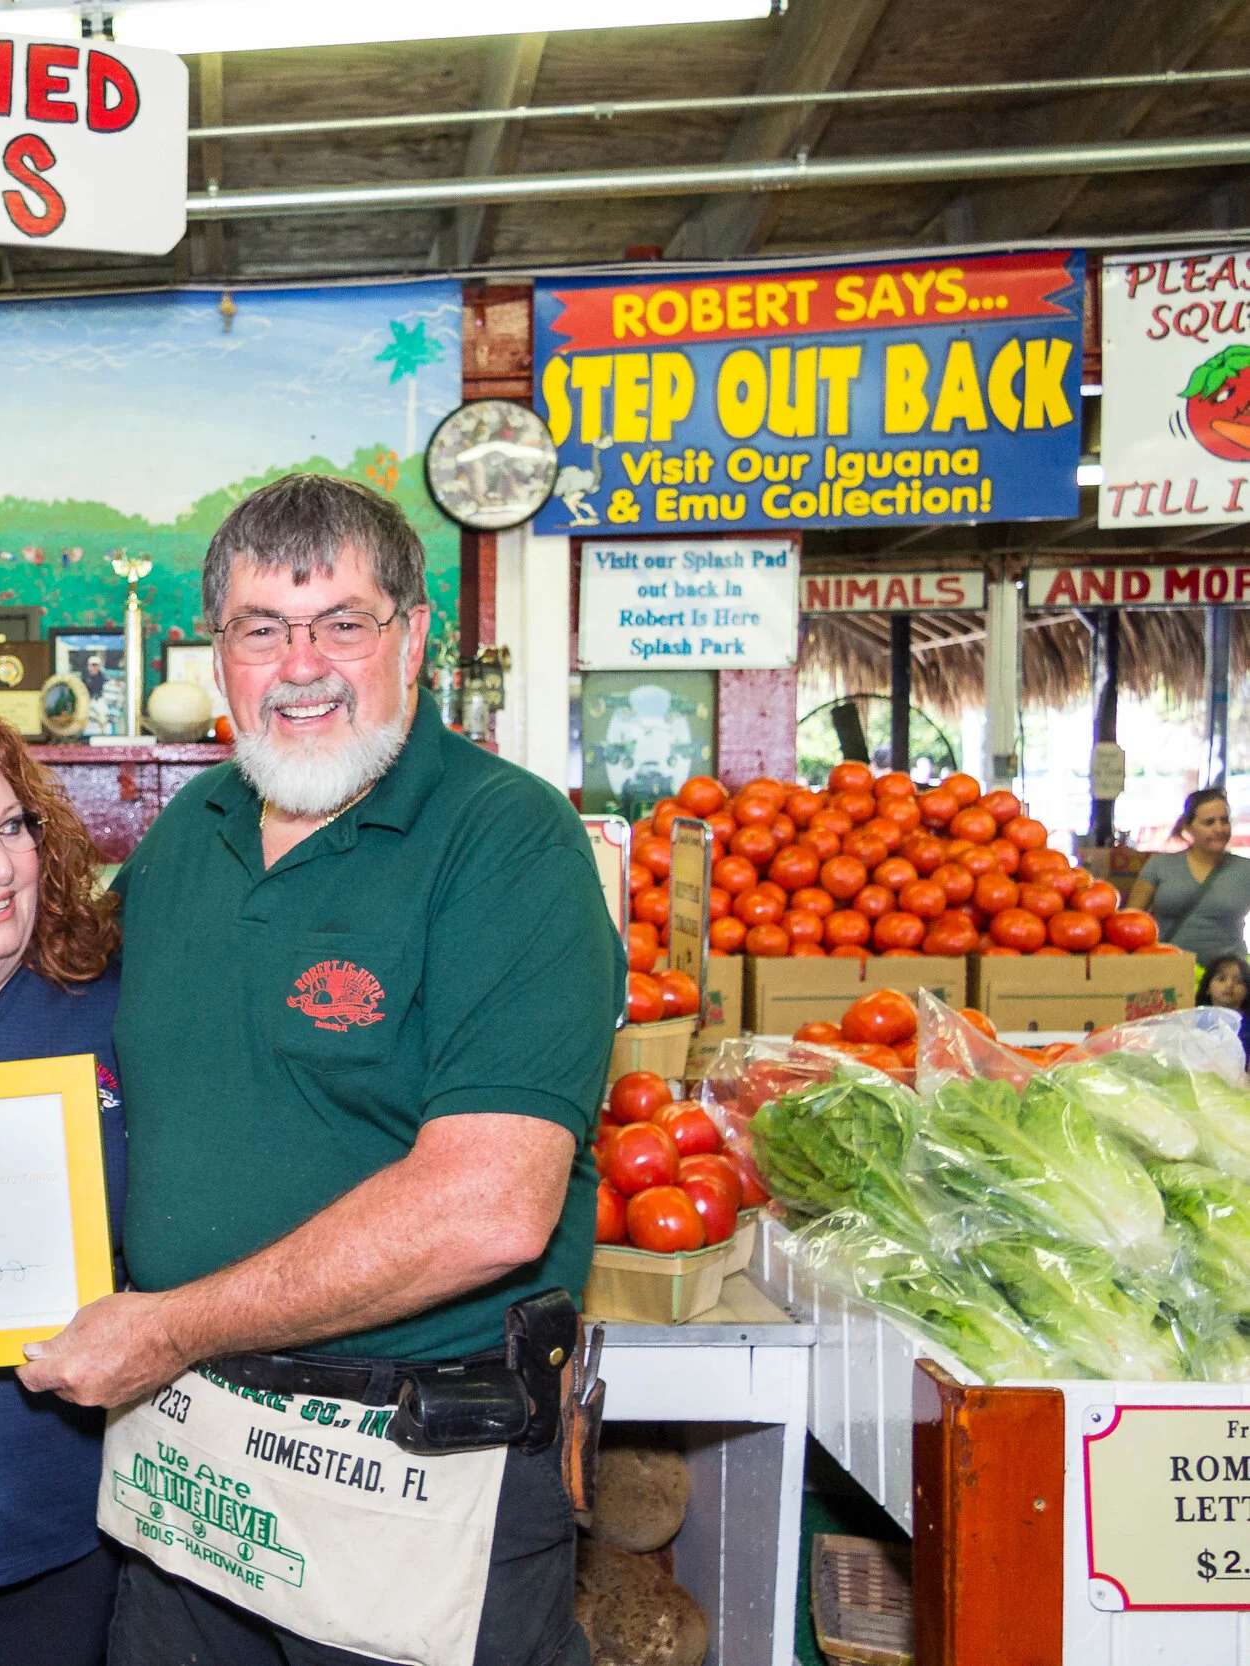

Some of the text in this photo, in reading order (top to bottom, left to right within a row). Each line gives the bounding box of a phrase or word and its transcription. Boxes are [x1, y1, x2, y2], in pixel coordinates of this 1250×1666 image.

[612, 267, 1009, 340] ROBERT SAYS...
[1146, 300, 1250, 343] SQU
[540, 336, 1074, 448] STEP OUT BACK
[621, 446, 979, 489] Visit Our Iguana
[607, 478, 992, 524] & Emu Collection!
[1107, 478, 1208, 518] TILL
[595, 550, 787, 572] Visit our Splash Pad
[638, 580, 742, 598] out back in
[801, 574, 966, 610] NIMALS
[1047, 568, 1150, 605] AND
[619, 608, 760, 627] Robert Is Here
[630, 638, 745, 660] Splash Park
[294, 960, 386, 1003] ROBERT IS HERE
[301, 1399, 351, 1429] CO.,
[357, 1409, 393, 1440] IN
[1227, 1420, 1250, 1438] Fr
[157, 1441, 251, 1499] We Are
[244, 1427, 428, 1502] HOMESTEAD, FL
[1170, 1455, 1250, 1482] ROM
[134, 1453, 280, 1551] ON THE LEVEL
